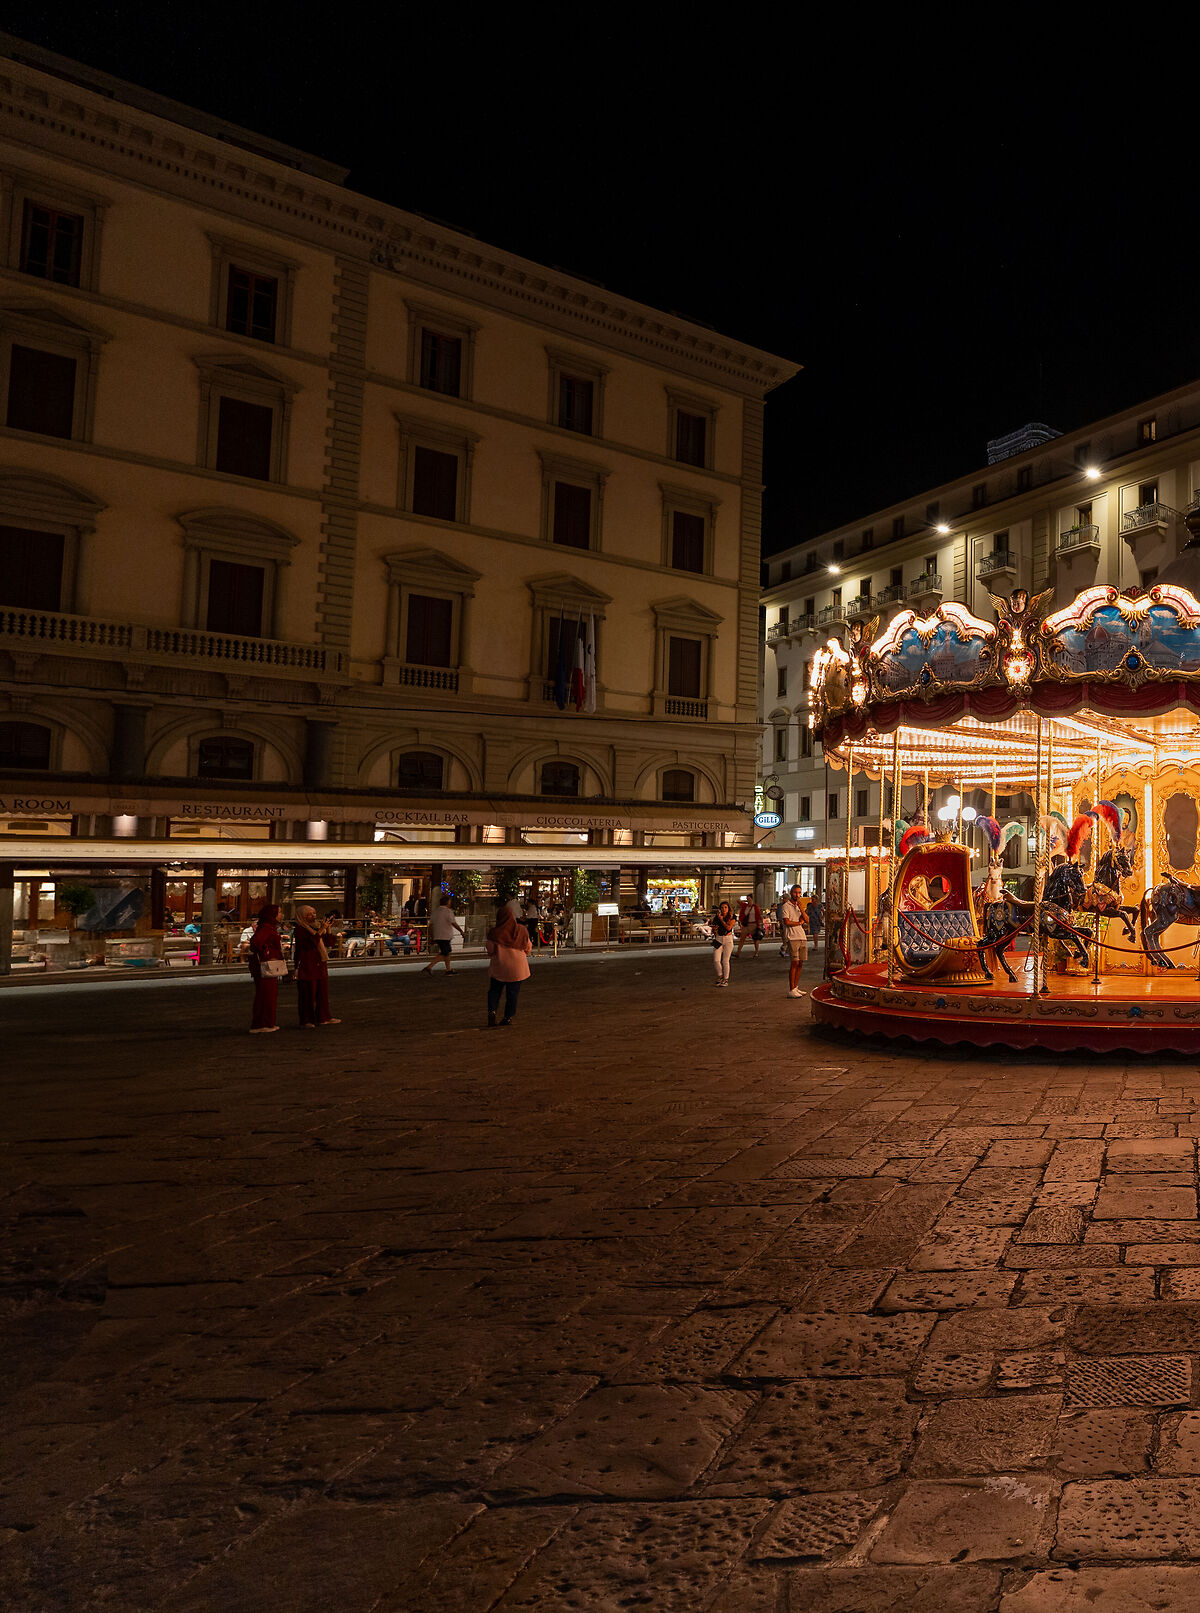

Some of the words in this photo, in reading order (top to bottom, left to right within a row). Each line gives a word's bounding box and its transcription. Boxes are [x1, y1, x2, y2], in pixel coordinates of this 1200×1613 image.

[13, 799, 71, 810] ROOM
[182, 804, 285, 817] RESTAURANT
[375, 810, 440, 822] COCKTAIL
[444, 813, 468, 822] BAR
[536, 816, 622, 827] CIOCCOLATERIA
[672, 821, 730, 830] PASTICCERIA
